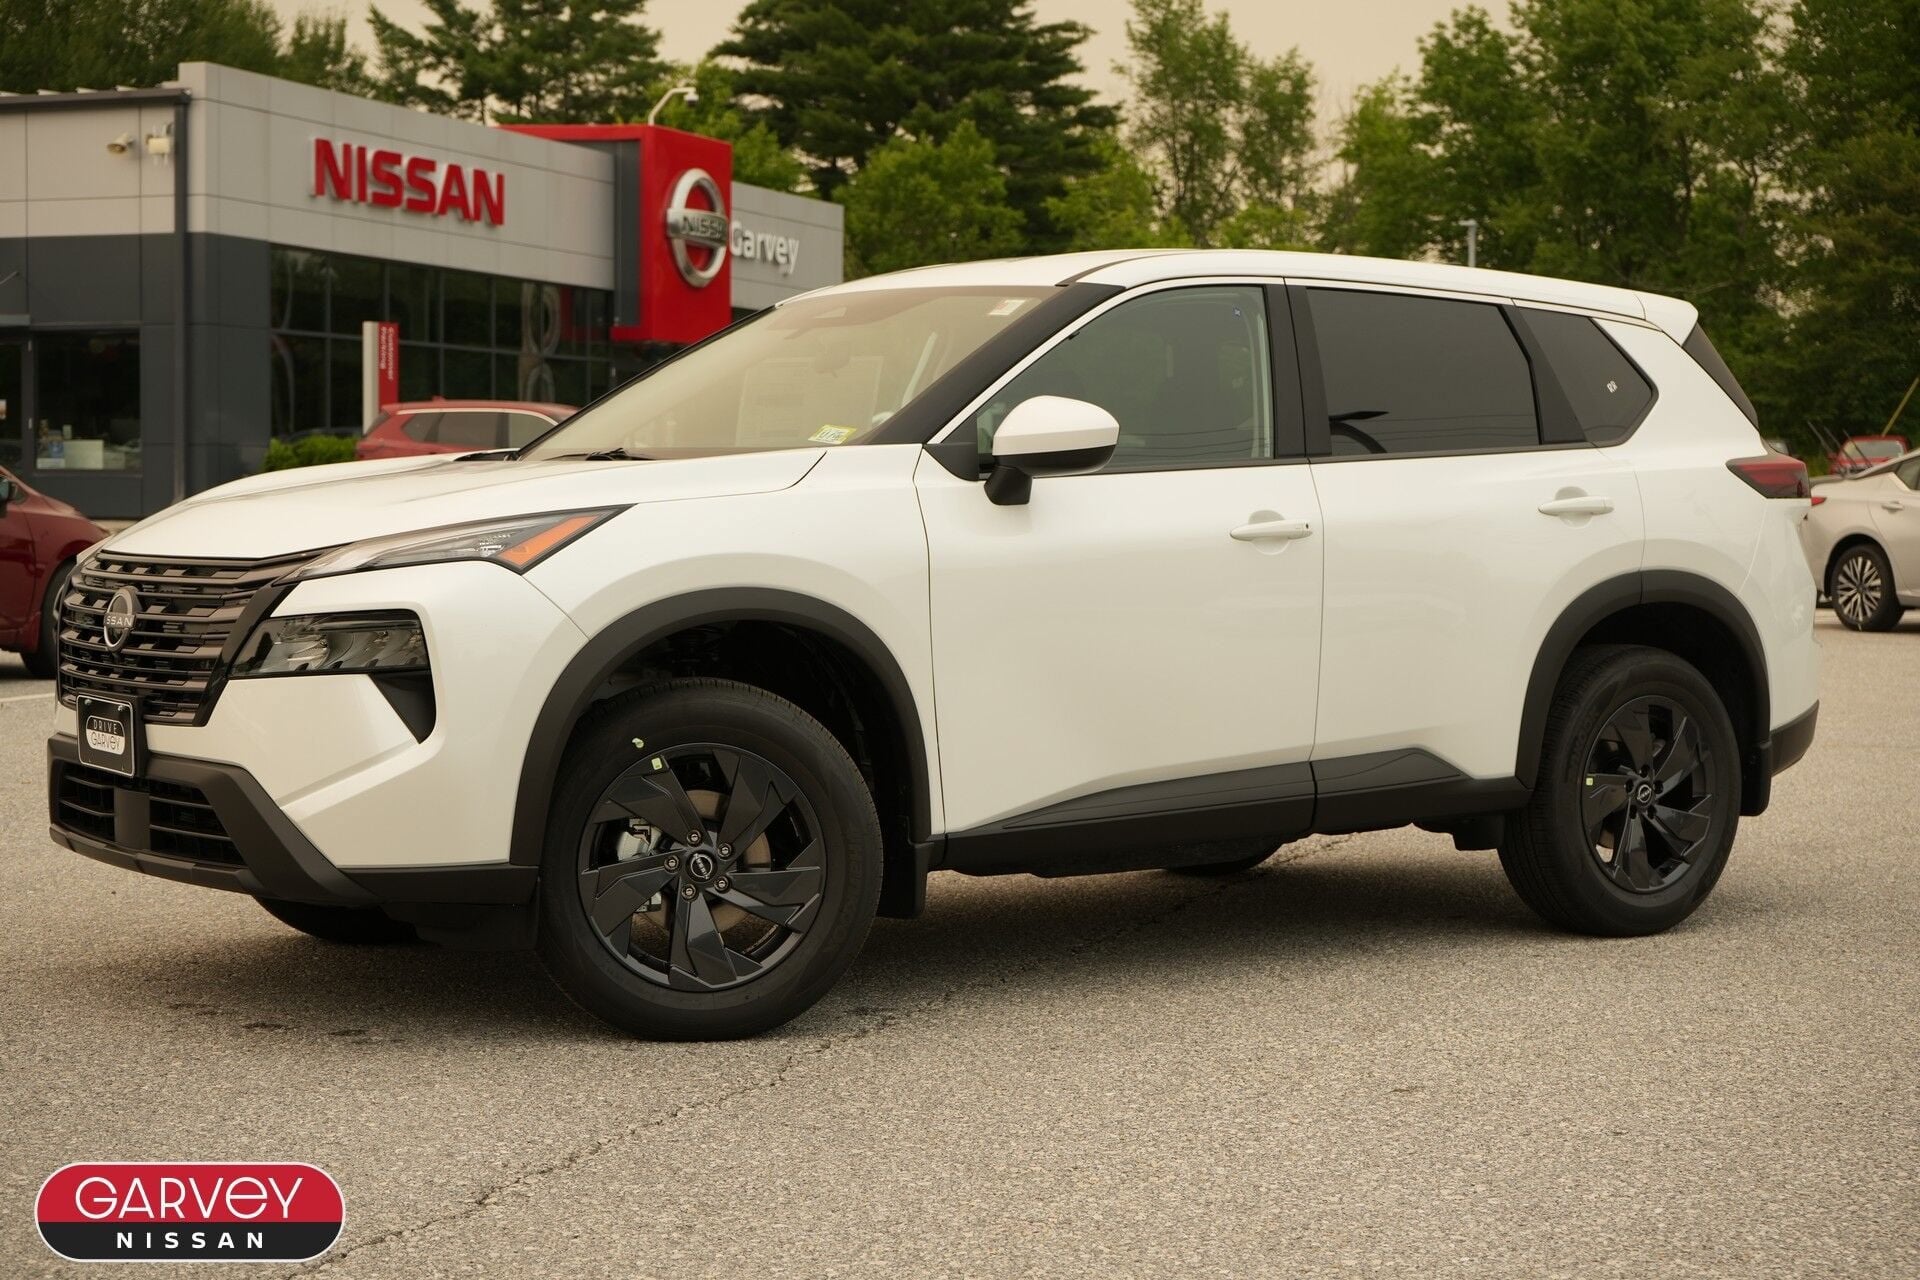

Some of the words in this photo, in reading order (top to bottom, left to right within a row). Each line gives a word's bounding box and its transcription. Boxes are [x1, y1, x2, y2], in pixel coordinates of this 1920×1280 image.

[314, 137, 505, 225] NISSAN
[681, 216, 723, 240] NISS
[730, 221, 800, 275] Garvey
[105, 615, 133, 626] SSAN
[93, 719, 117, 734] DRIVE
